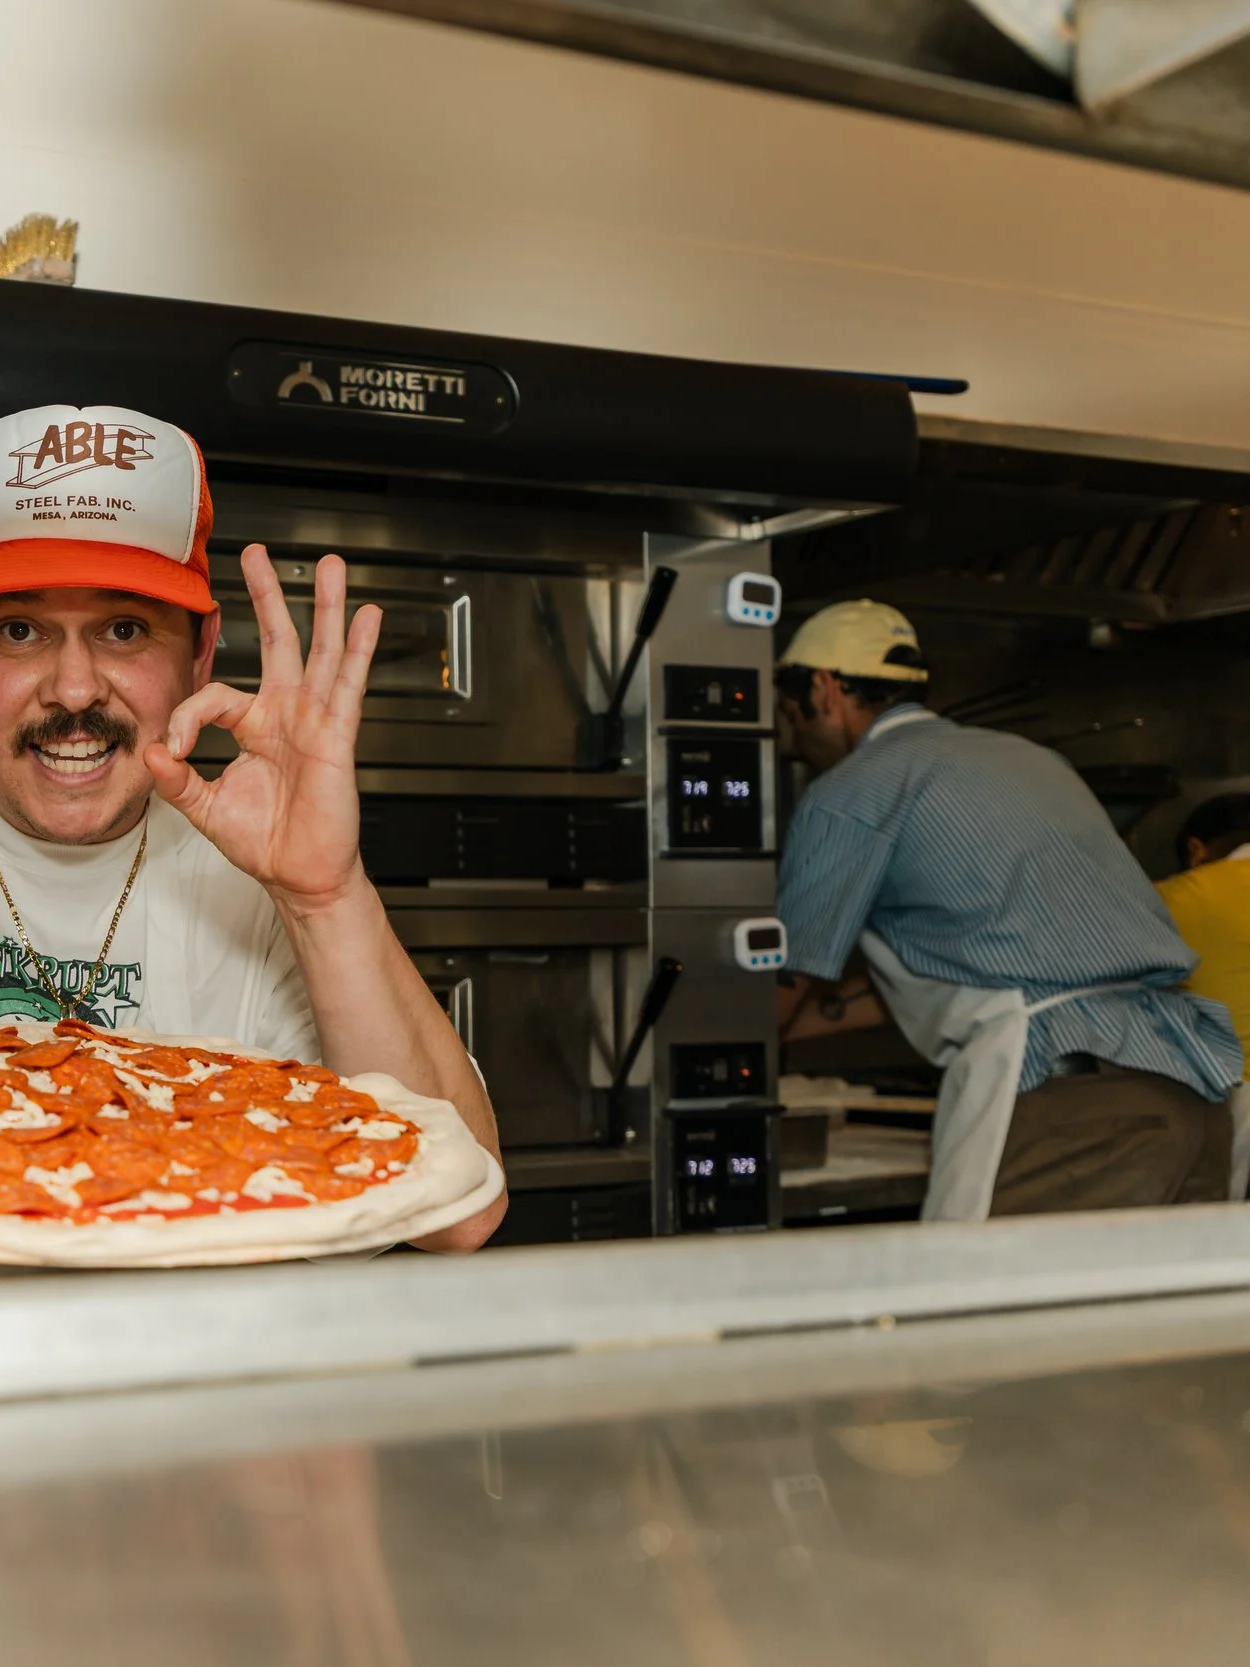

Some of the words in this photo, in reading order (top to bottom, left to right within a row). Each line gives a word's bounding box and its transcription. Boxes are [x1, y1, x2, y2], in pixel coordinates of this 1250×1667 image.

[339, 365, 466, 396] MORETTI
[339, 386, 426, 412] FORNI
[33, 421, 137, 470] ABLE
[15, 496, 62, 511] STEEL
[67, 495, 101, 507] FAB.
[106, 497, 136, 512] INC.
[70, 511, 118, 521] ARIZONA
